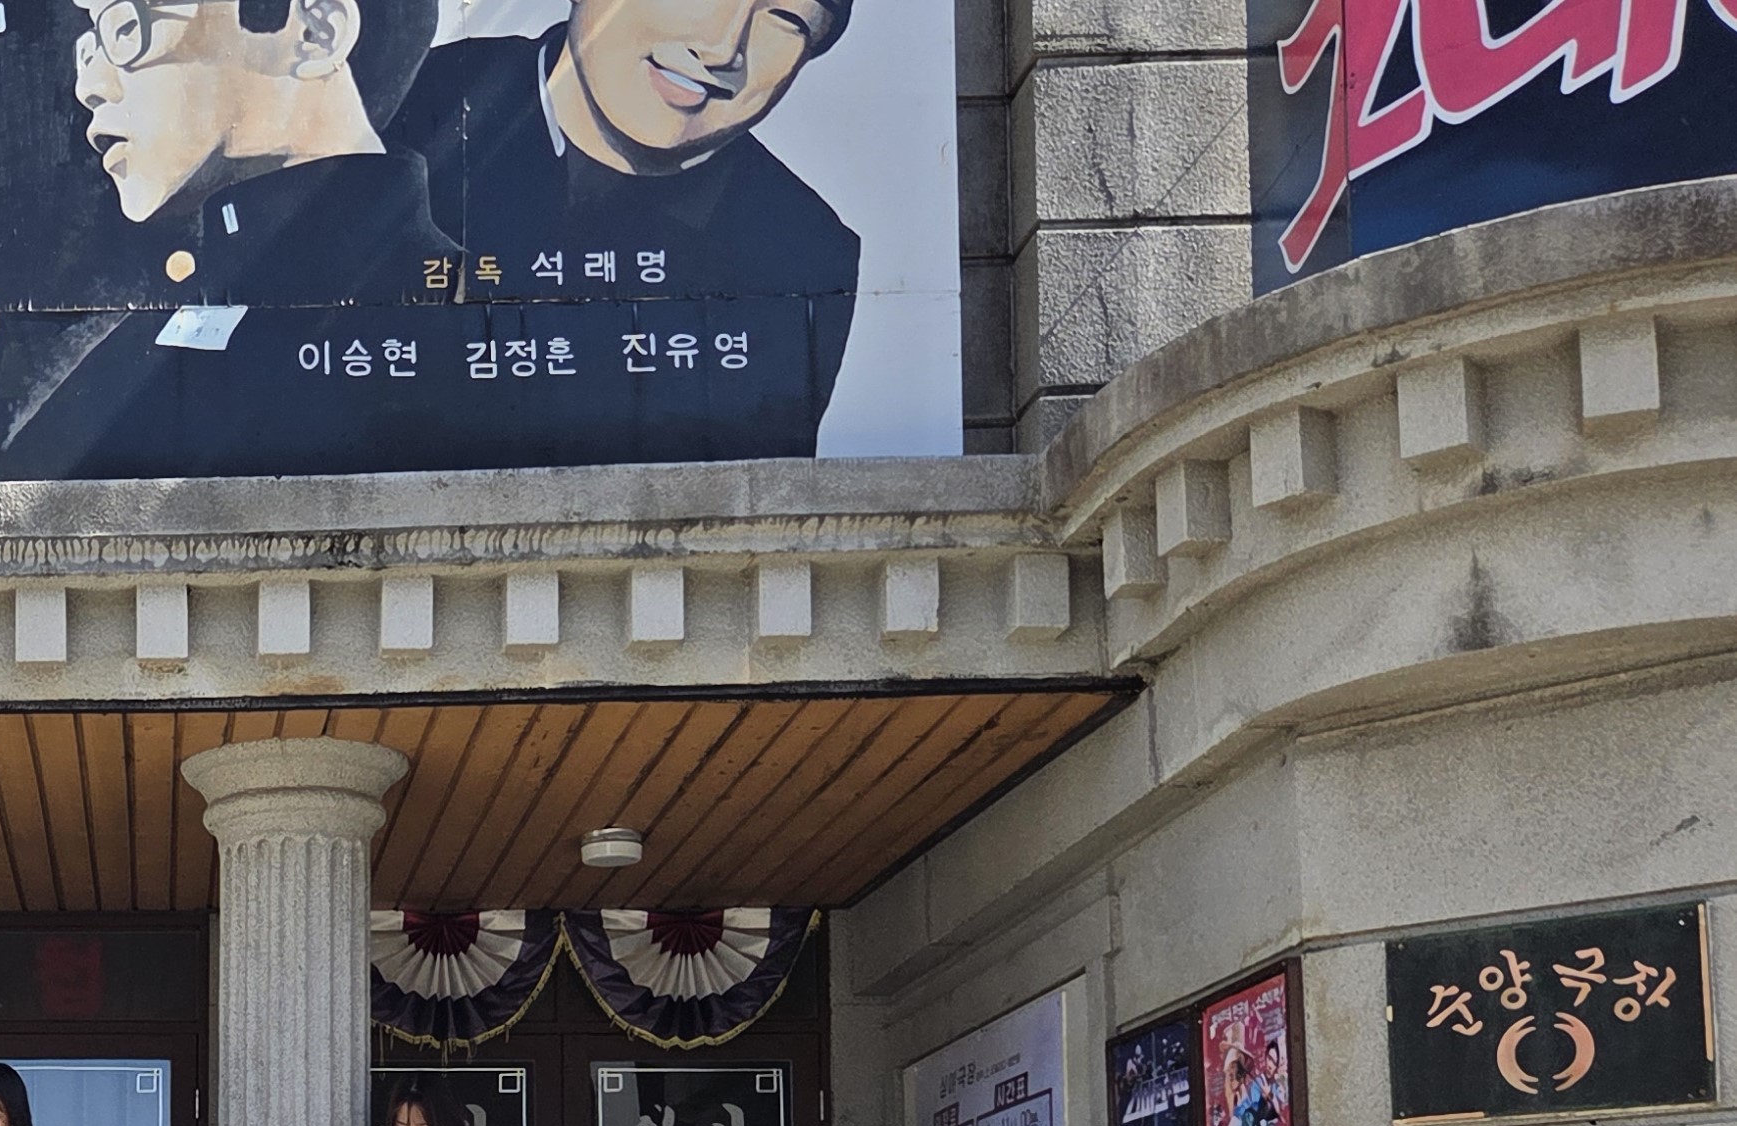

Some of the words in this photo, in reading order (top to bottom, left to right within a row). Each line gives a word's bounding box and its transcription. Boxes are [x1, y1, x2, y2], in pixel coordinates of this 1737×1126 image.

[422, 256, 503, 290] 감독
[531, 249, 667, 285] 석래명
[298, 337, 419, 378] 이승현
[465, 336, 578, 379] 김정훈
[620, 331, 751, 374] 진유영
